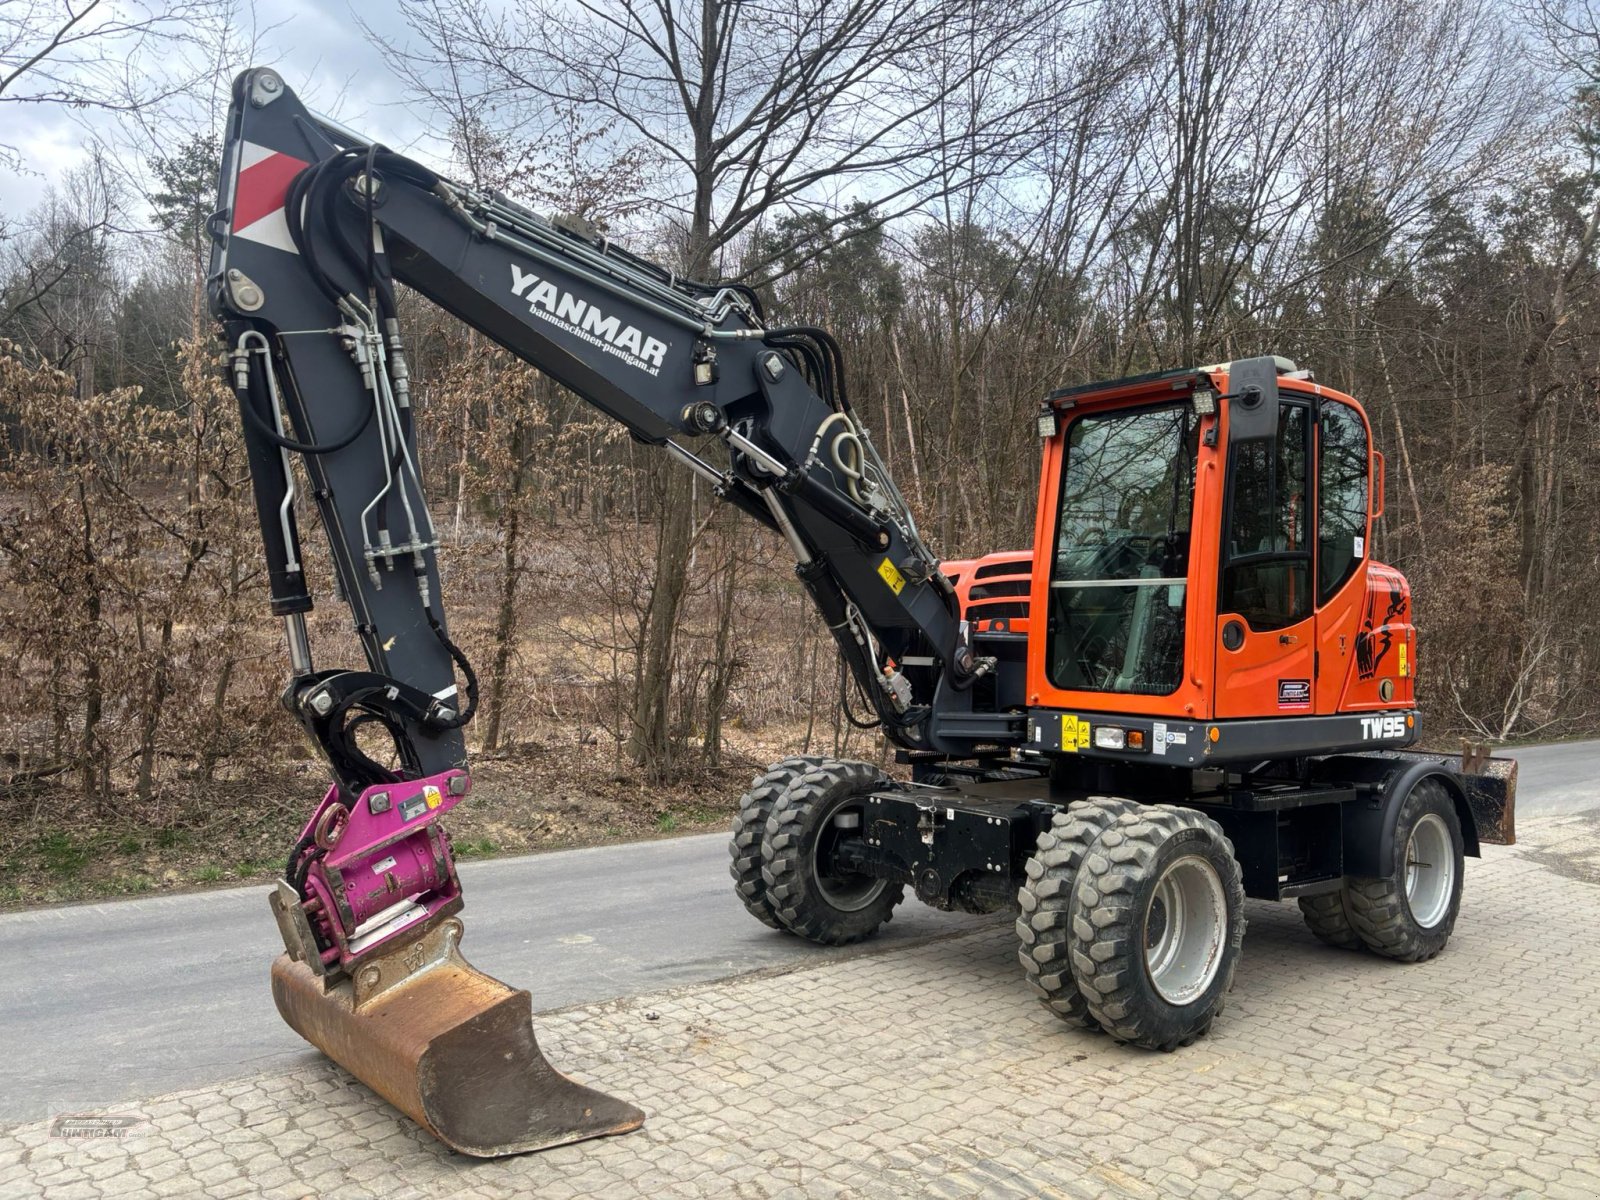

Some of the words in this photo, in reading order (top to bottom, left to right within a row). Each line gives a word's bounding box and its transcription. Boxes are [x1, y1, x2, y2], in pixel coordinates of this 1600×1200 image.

[510, 263, 668, 368] YANMAR
[528, 303, 660, 377] baumaschinen-puntigam.at
[1360, 716, 1405, 740] TW95
